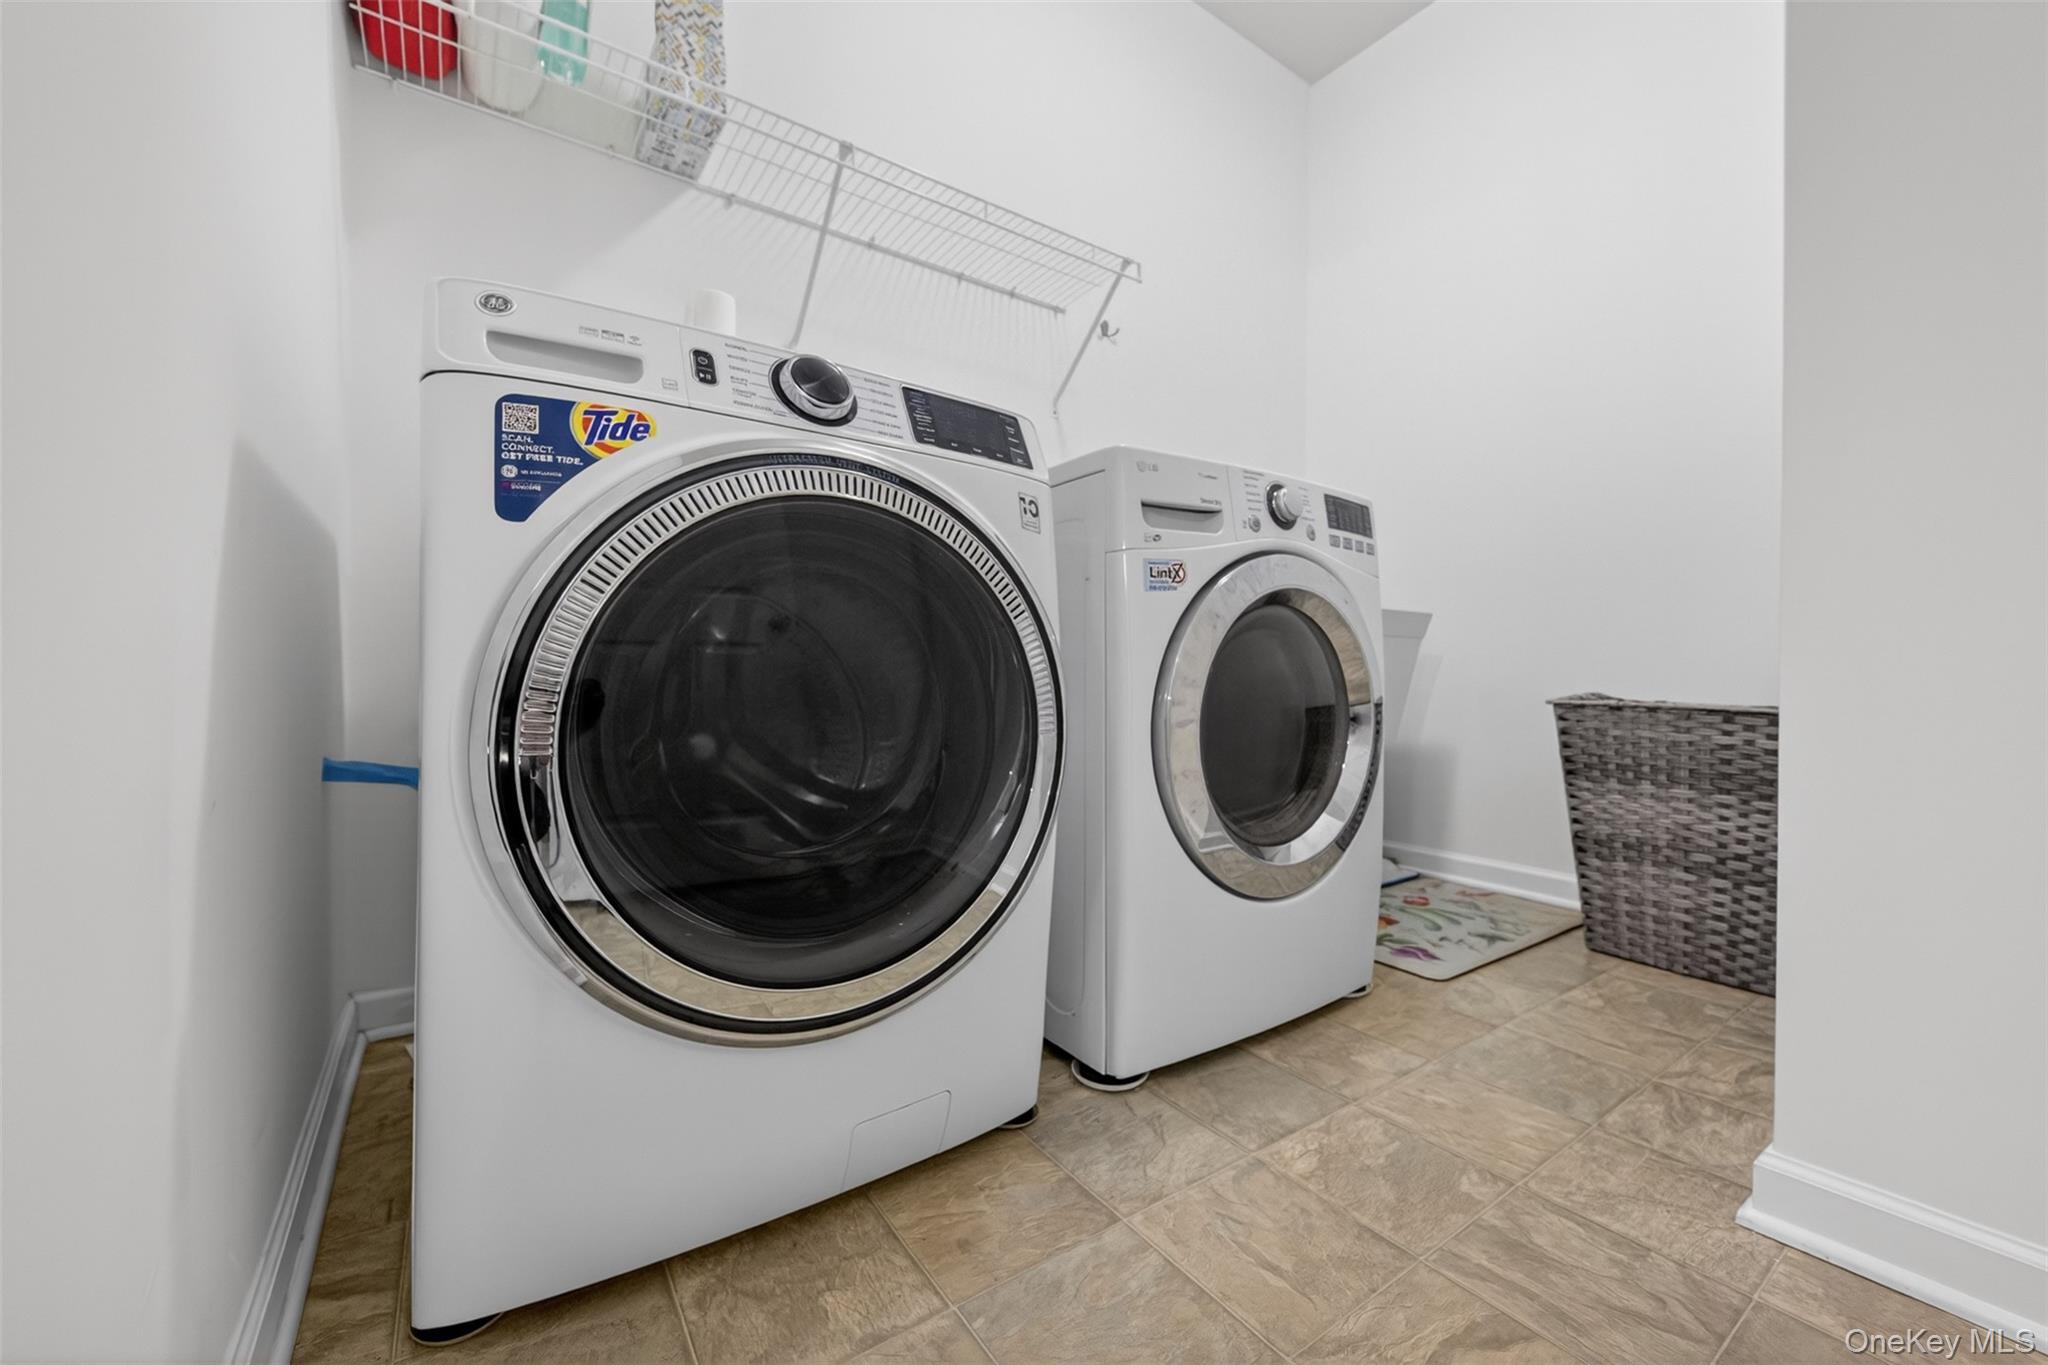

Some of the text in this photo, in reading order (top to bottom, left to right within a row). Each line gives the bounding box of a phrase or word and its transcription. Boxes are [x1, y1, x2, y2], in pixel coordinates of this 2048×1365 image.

[582, 409, 651, 446] Tide
[502, 433, 533, 443] SCAN.
[501, 442, 555, 454] CONNECT.
[556, 455, 584, 466] TIDE.
[1149, 562, 1185, 584] LintX
